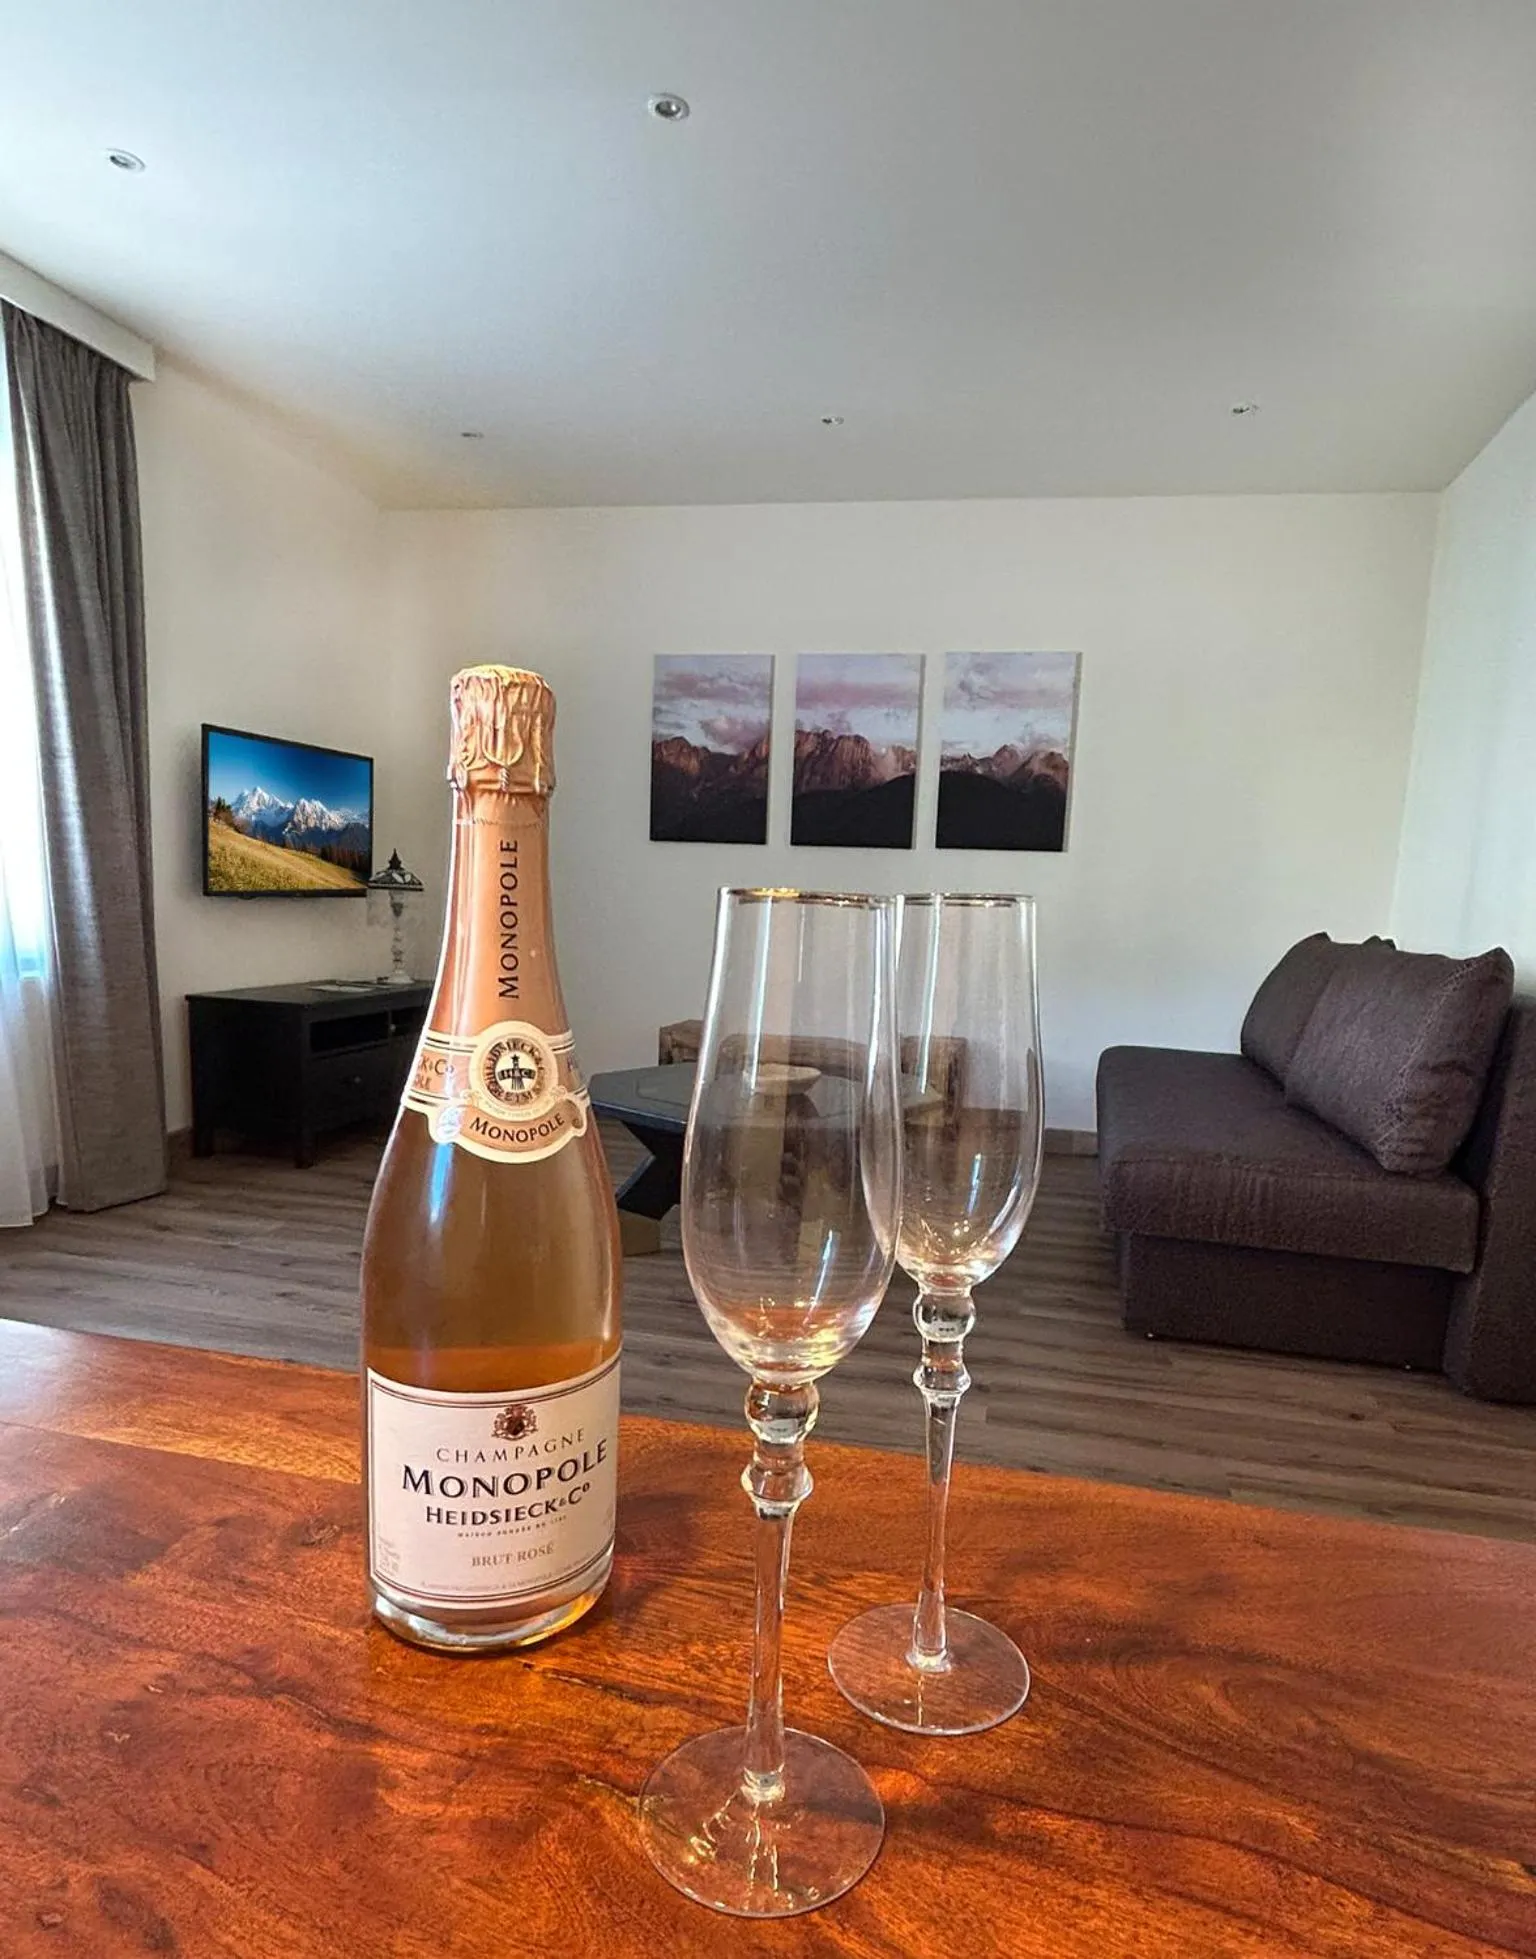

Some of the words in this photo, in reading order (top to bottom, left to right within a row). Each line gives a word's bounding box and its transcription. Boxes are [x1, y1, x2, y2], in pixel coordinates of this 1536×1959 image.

[499, 839, 519, 999] MONOPOLE
[470, 1113, 565, 1143] MONOPOLE
[436, 1428, 585, 1463] CHAMPAGNE
[402, 1438, 608, 1499] MONOPOLE
[471, 1553, 512, 1567] BRUT
